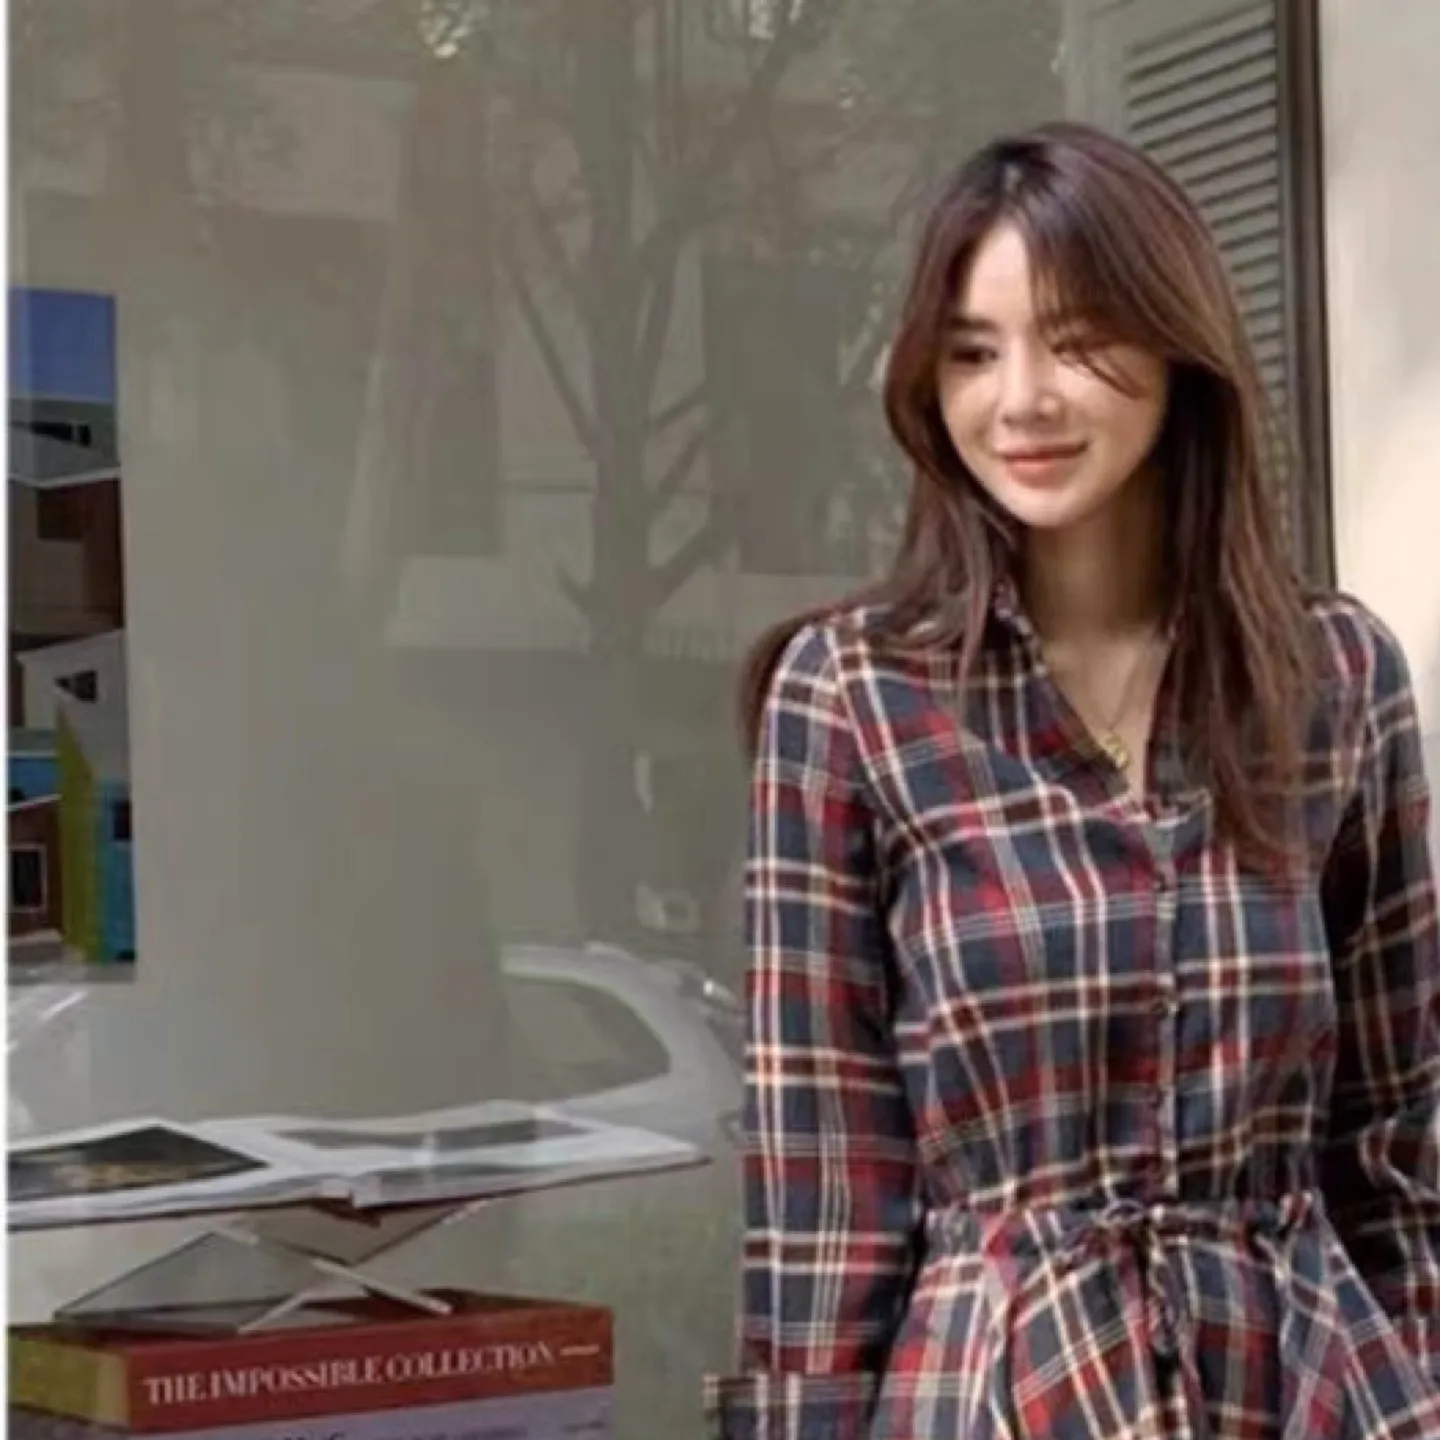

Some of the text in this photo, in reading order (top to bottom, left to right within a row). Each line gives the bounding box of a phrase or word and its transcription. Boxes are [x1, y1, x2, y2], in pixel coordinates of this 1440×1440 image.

[143, 1340, 556, 1404] THE IMPOSSIBLE COLLECTION
